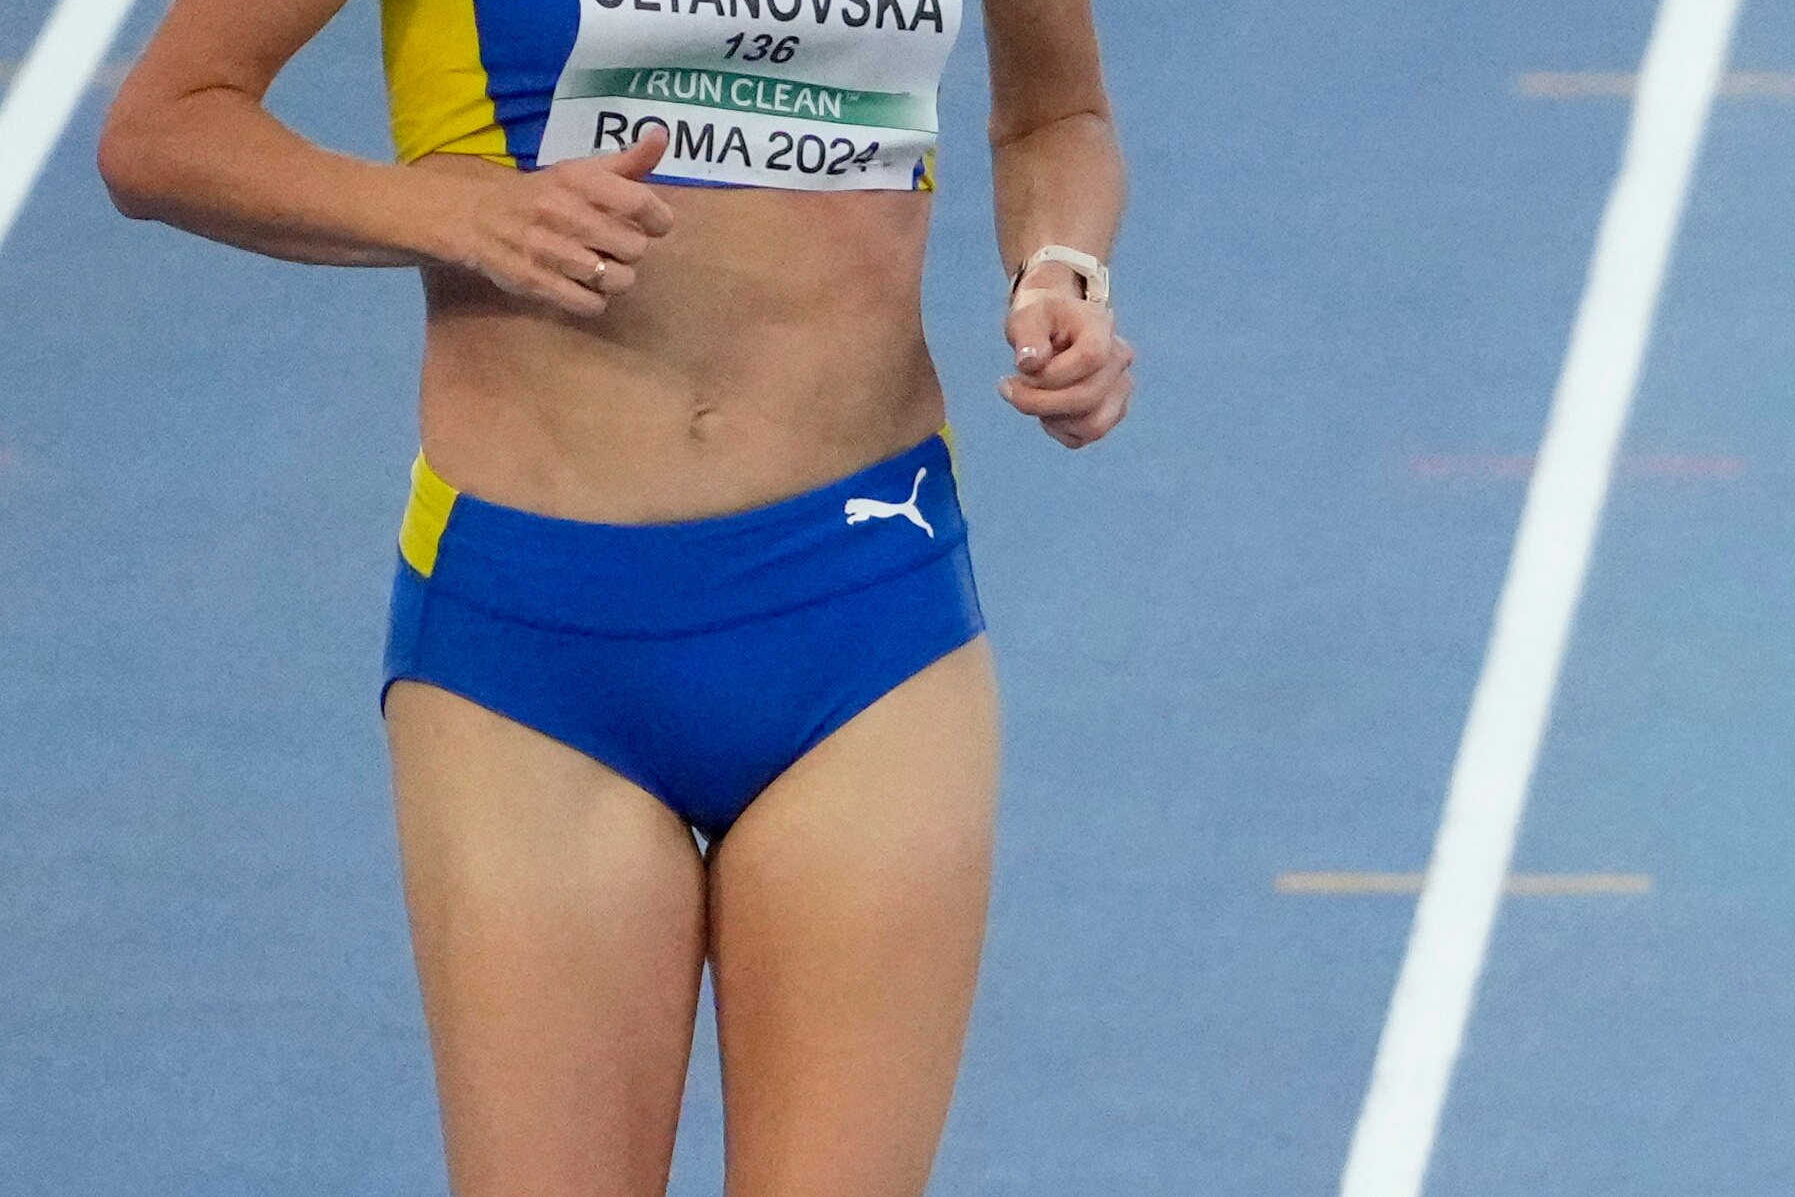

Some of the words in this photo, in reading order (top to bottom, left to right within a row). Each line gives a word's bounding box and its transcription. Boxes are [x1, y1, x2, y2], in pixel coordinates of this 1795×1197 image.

[722, 32, 800, 64] 136
[647, 70, 723, 103] RUN
[765, 130, 880, 176] 2024
